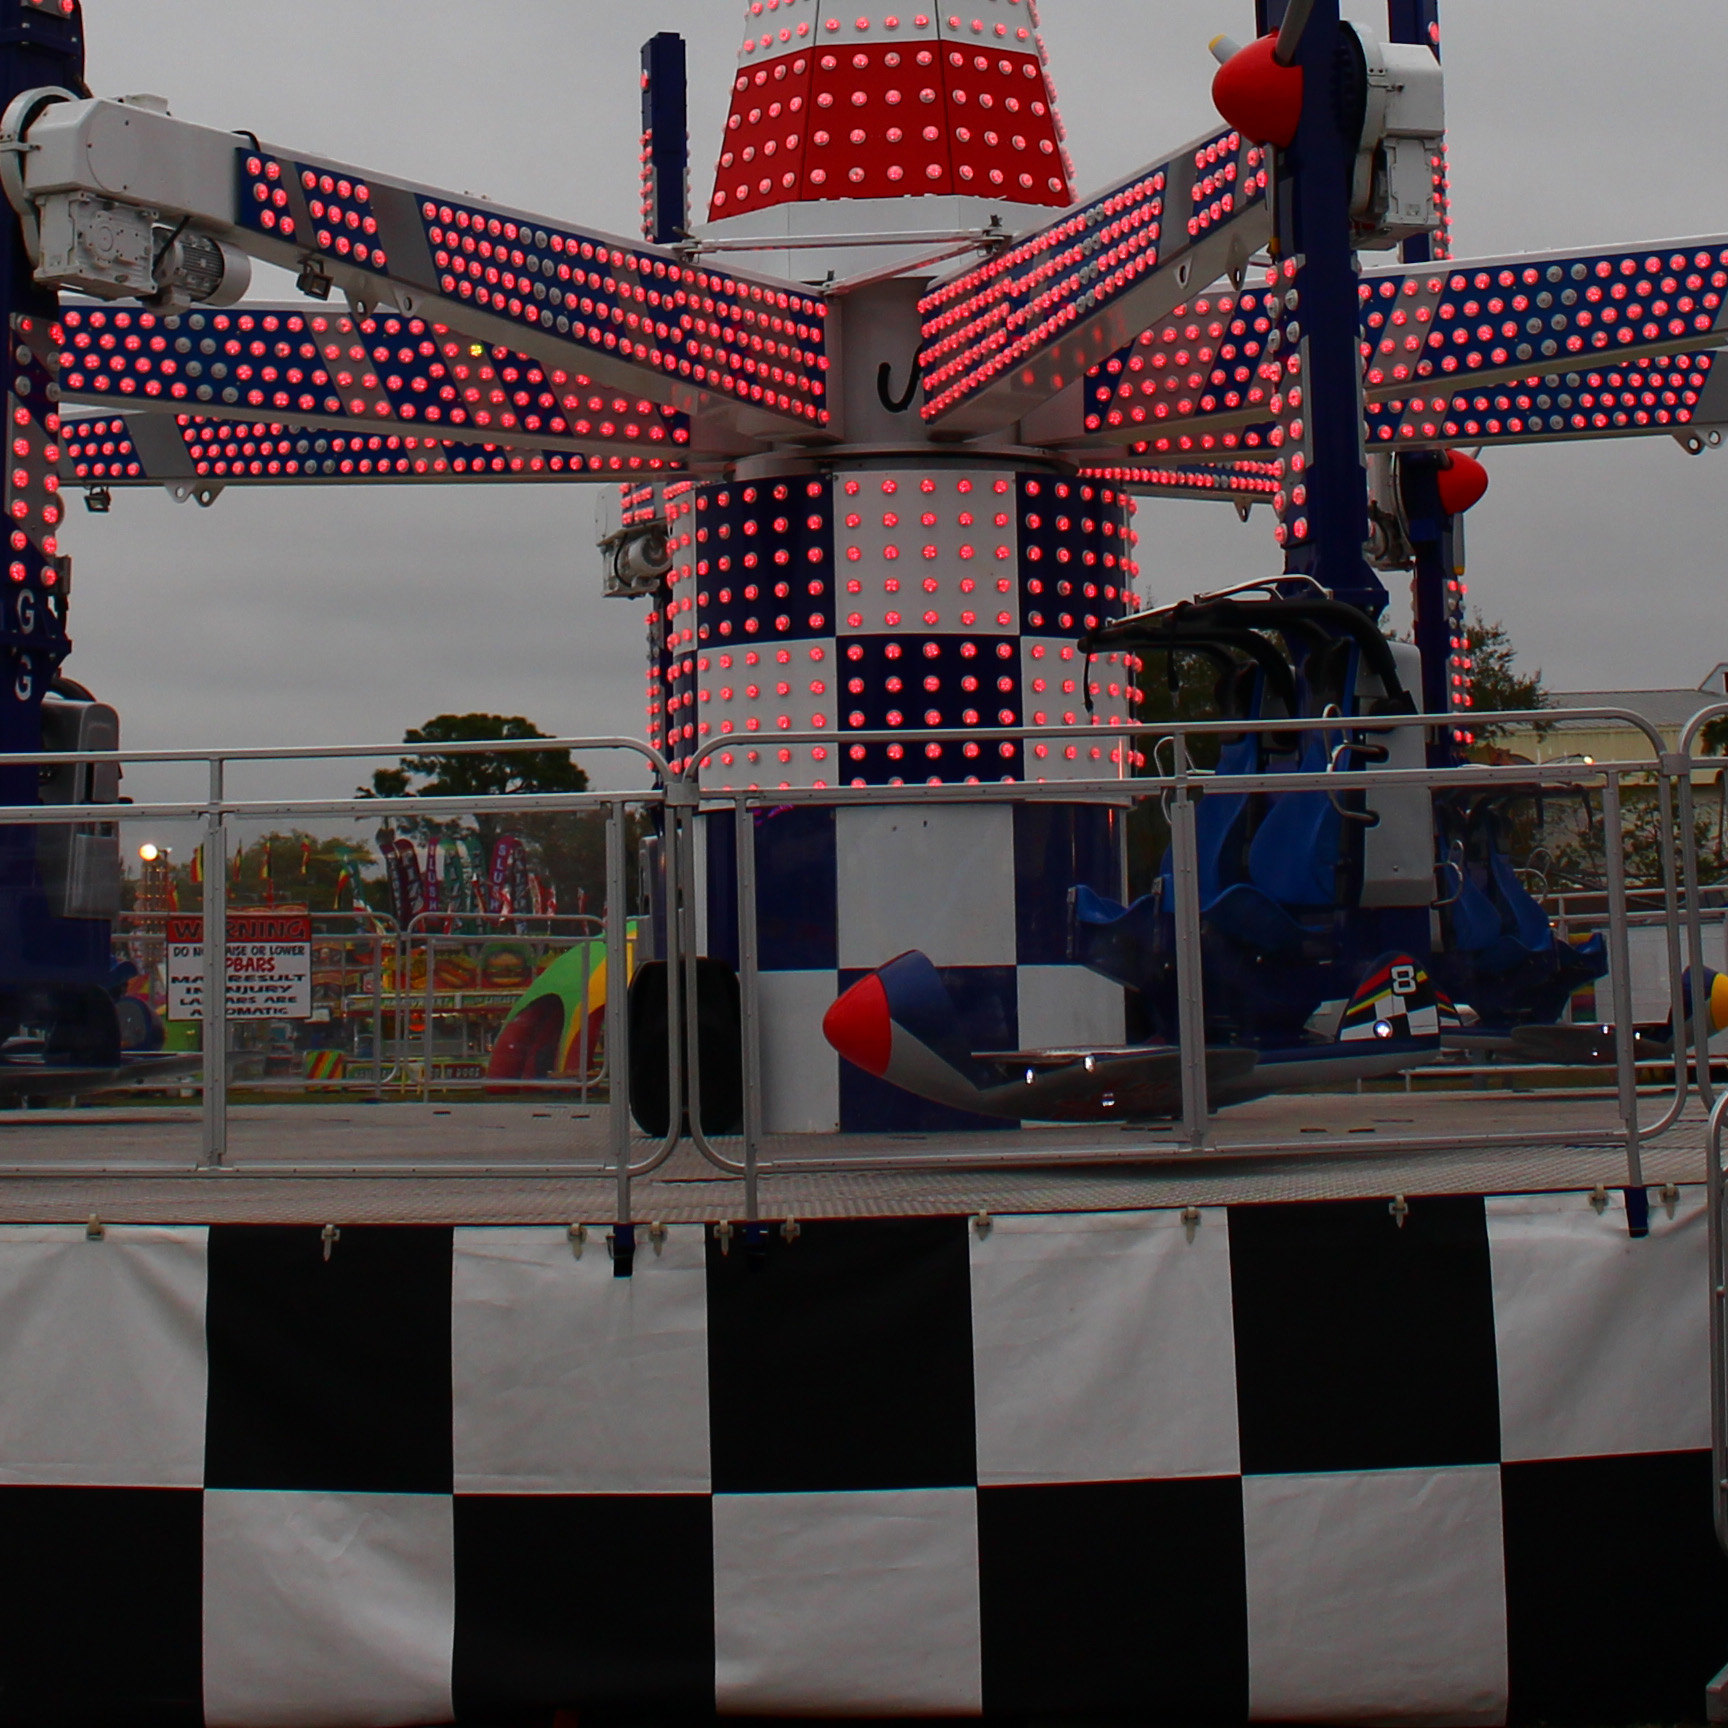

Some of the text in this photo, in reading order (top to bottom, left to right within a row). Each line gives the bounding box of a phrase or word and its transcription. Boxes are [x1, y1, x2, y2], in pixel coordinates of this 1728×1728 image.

[16, 588, 35, 635] G
[14, 653, 32, 702] G
[172, 919, 306, 939] WRNING
[174, 947, 189, 957] DO
[225, 946, 247, 956] AISE
[251, 946, 266, 957] OR
[269, 945, 305, 956] LOWER
[225, 957, 275, 972] PBARS
[171, 974, 306, 984] MA RESULT
[1391, 964, 1417, 994] 8
[225, 985, 294, 994] NJURY
[180, 996, 298, 1006] LAARS ARE
[190, 1007, 289, 1016] AOMATIC
